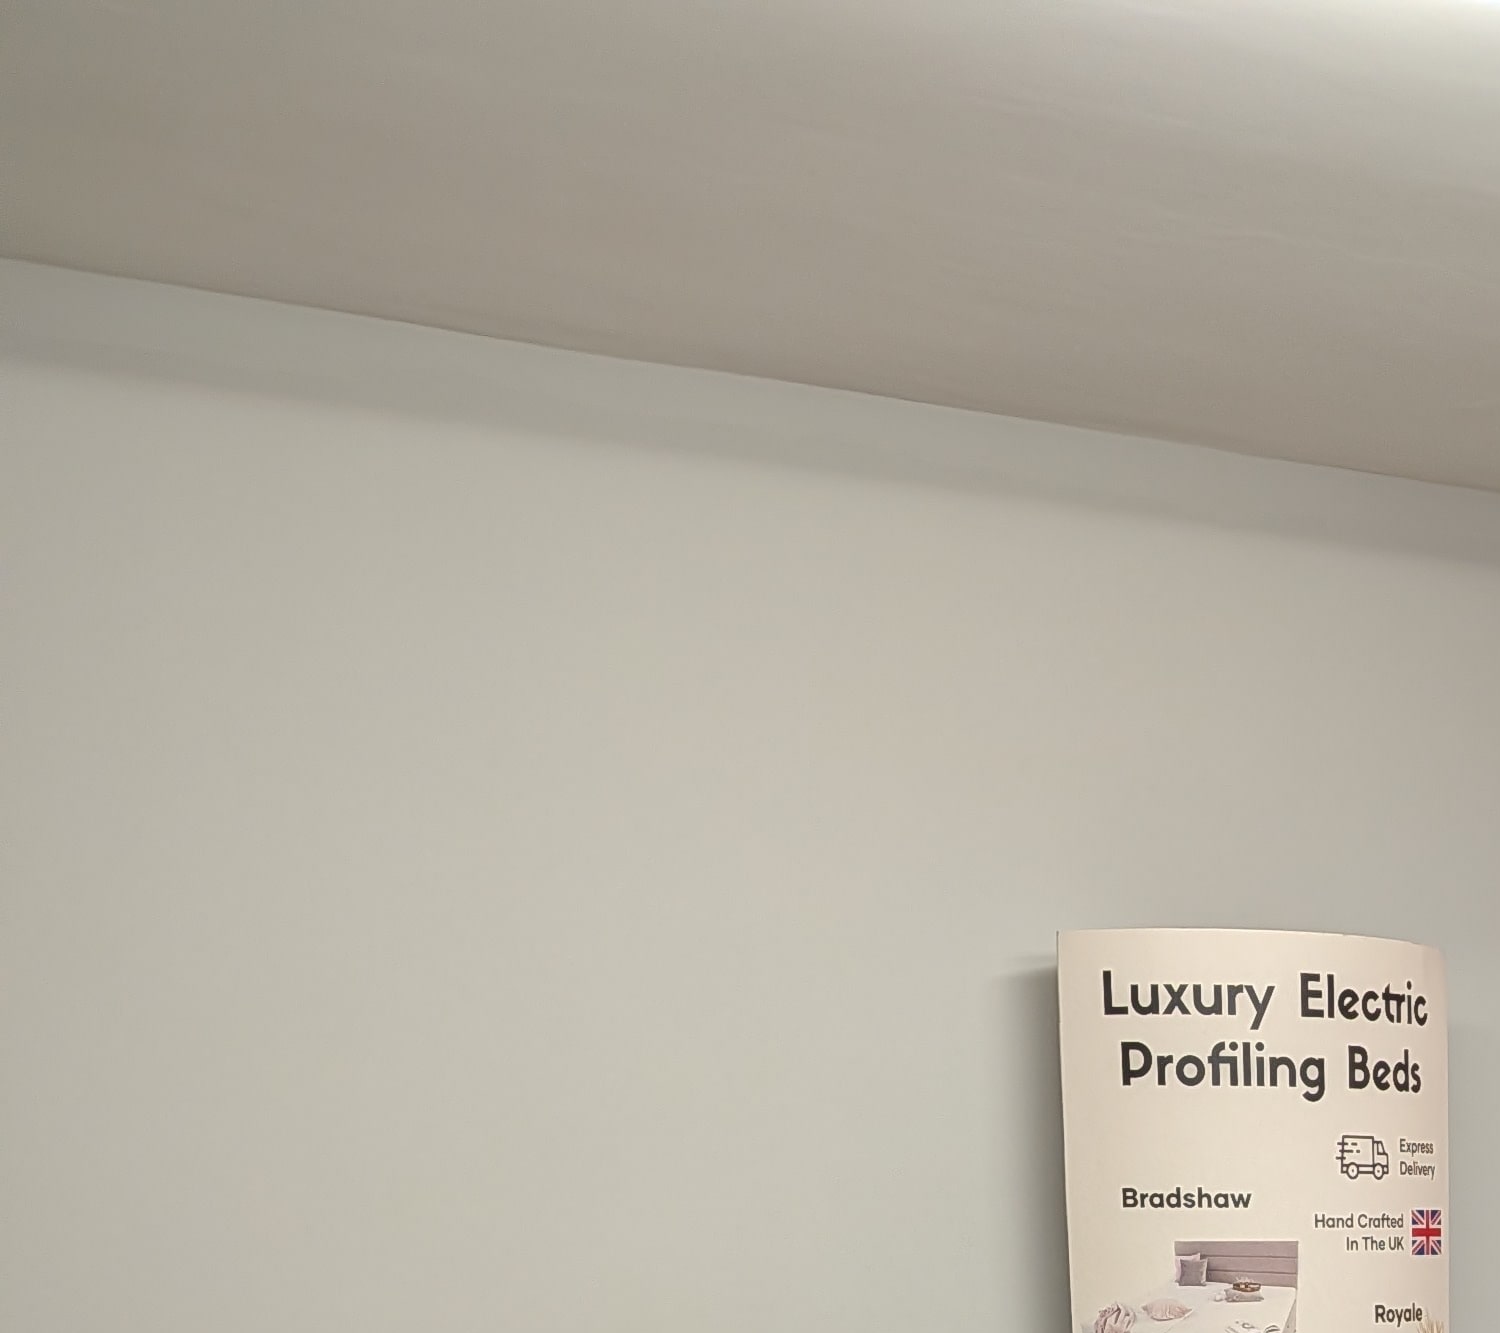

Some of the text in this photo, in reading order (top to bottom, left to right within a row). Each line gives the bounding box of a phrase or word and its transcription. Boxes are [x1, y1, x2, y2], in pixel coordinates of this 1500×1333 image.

[1102, 970, 1428, 1030] Luxury Electric
[1121, 1041, 1421, 1102] Profiling Beds
[1399, 1138, 1434, 1156] Express
[1399, 1161, 1436, 1180] Delivery
[1122, 1187, 1251, 1208] Bradshaw
[1314, 1213, 1404, 1229] Hand Crafted
[1346, 1236, 1404, 1252] In The UK
[1374, 1303, 1423, 1327] Royale
